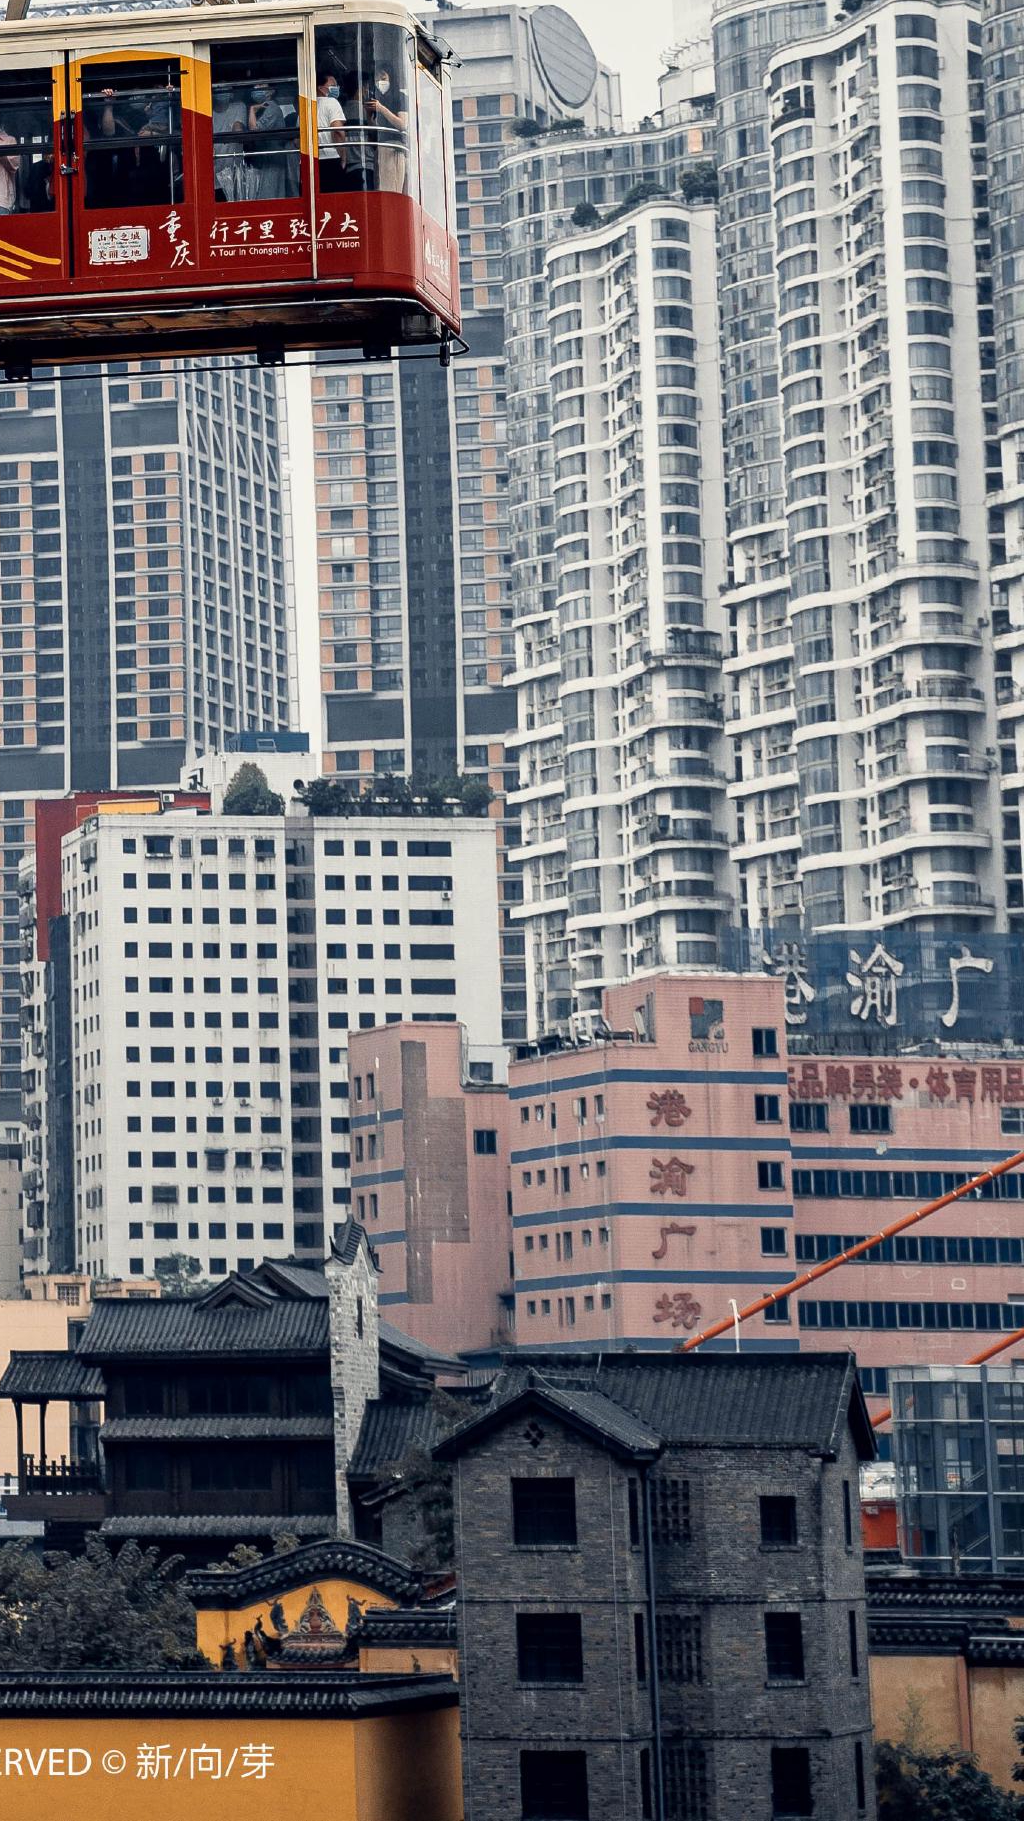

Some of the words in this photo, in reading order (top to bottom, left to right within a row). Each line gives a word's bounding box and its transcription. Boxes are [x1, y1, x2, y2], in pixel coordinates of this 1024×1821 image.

[159, 211, 195, 268] 重庆
[219, 248, 236, 256] Tour
[307, 243, 324, 253] Gin
[336, 240, 360, 249] Vision
[646, 1089, 702, 1330] 港渝广场
